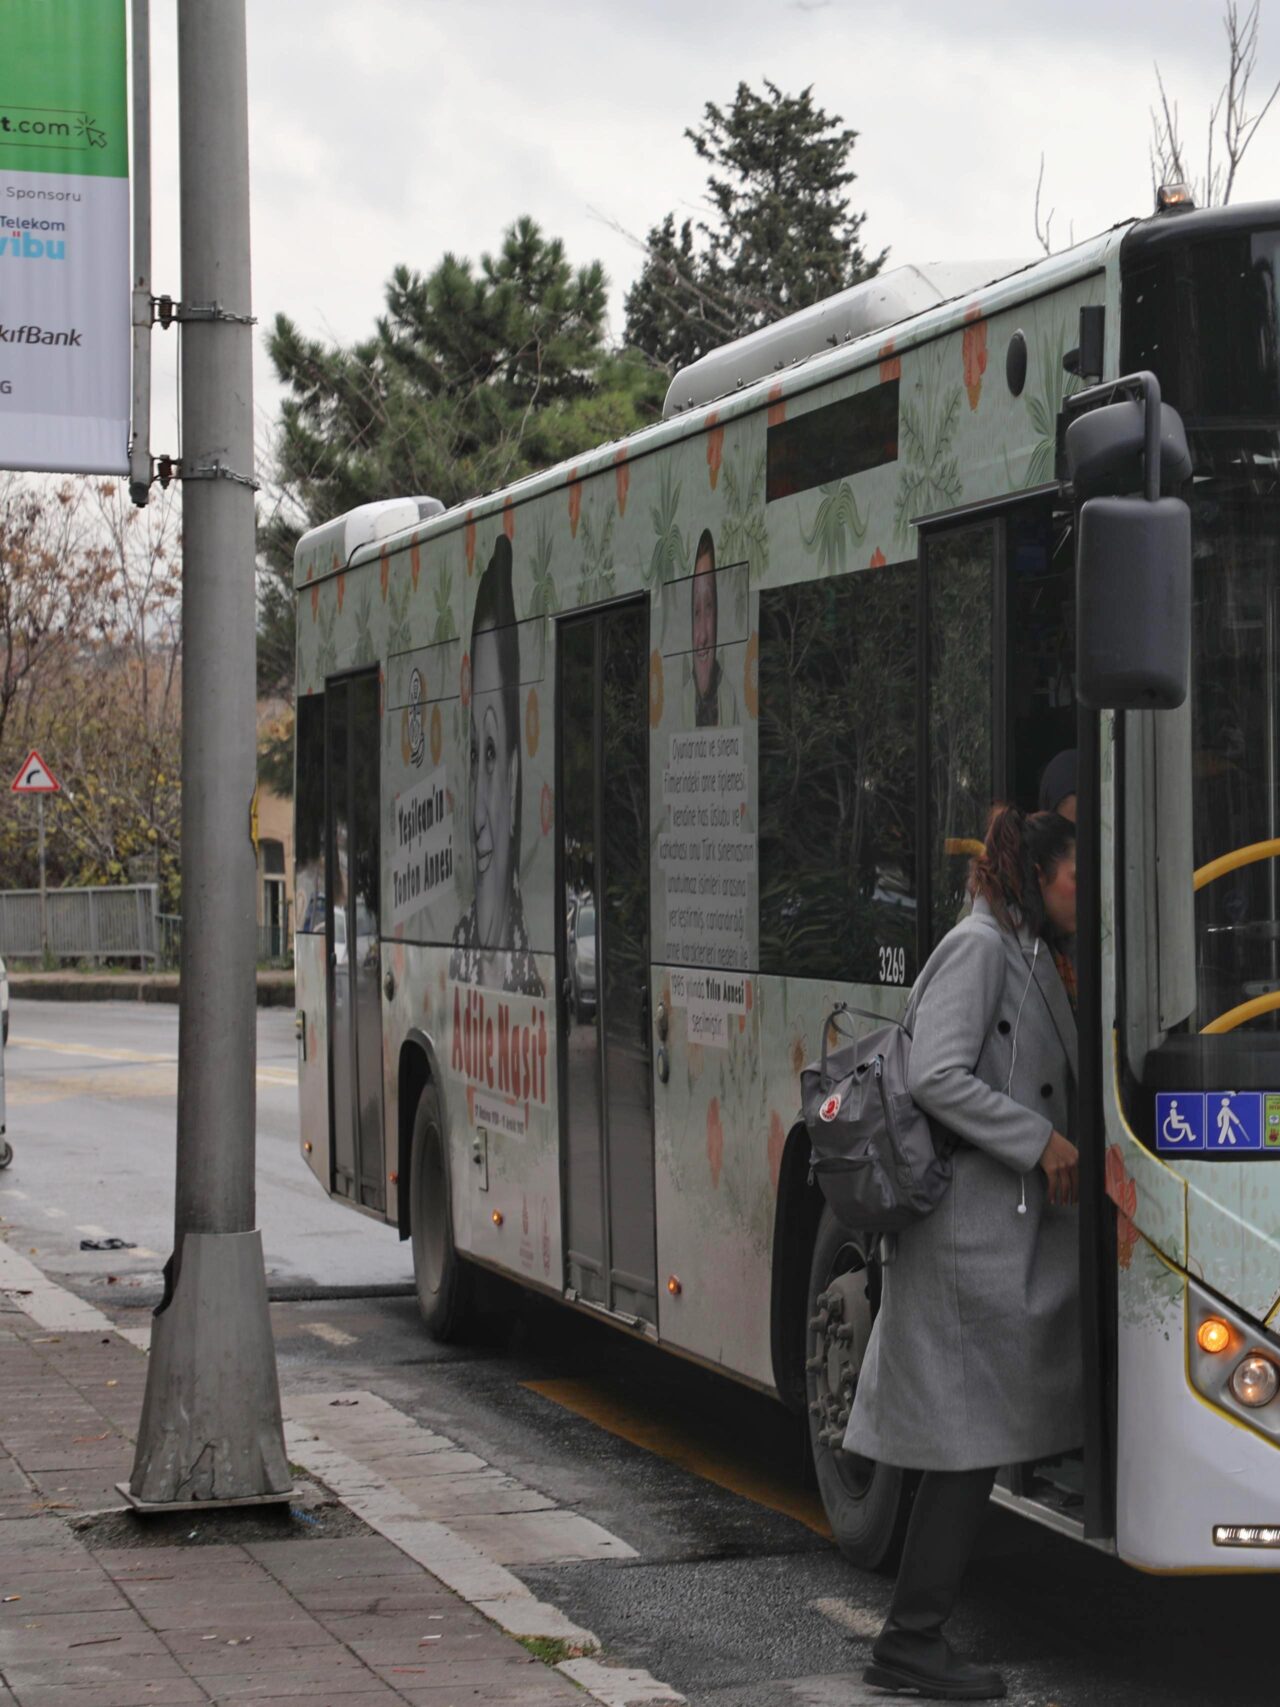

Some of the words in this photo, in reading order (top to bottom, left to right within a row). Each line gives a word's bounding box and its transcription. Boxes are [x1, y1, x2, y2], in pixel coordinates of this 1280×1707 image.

[6, 186, 82, 202] Sponsoru
[0, 215, 66, 231] Telekom
[399, 784, 444, 853] Yeşilçam'ın
[394, 862, 420, 909] Tonton
[424, 834, 452, 892] Annesi
[879, 946, 905, 985] 3269
[452, 986, 494, 1089] Adile
[498, 1003, 547, 1131] Naşit
